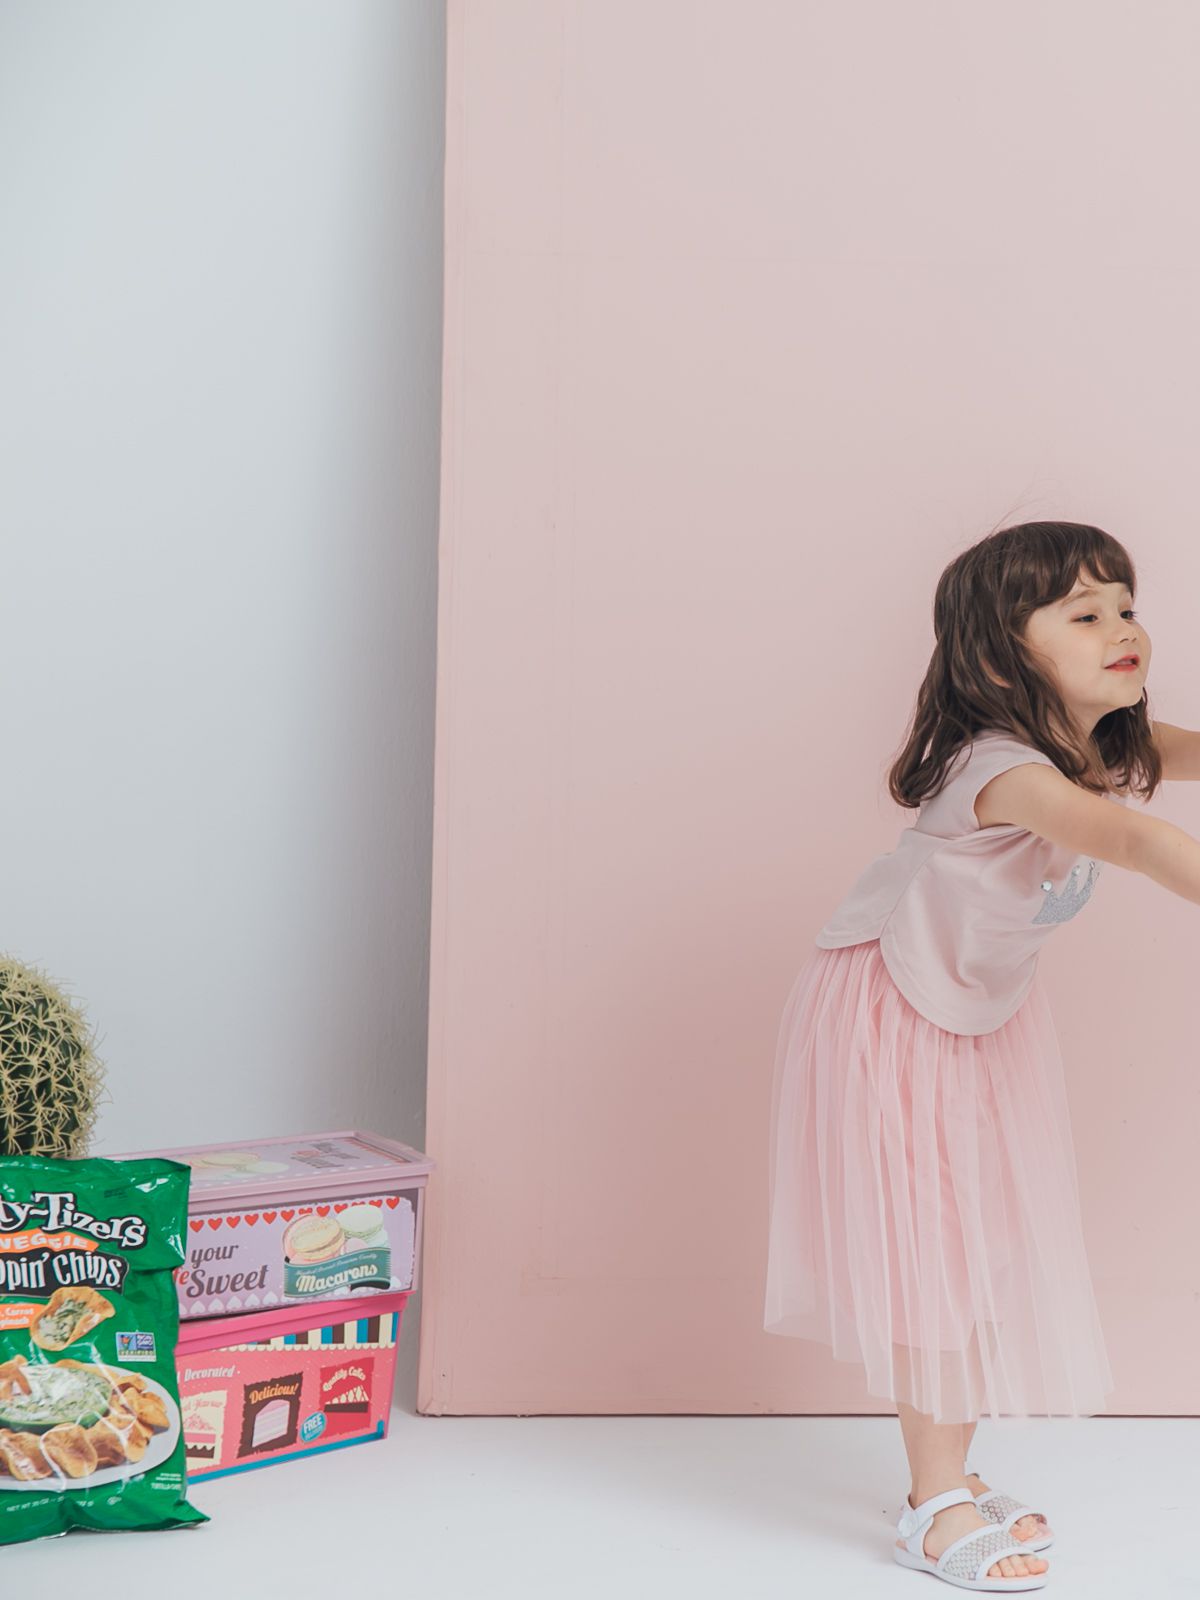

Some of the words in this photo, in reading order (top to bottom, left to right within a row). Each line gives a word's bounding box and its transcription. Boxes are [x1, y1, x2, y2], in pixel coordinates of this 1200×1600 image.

[190, 1243, 239, 1269] your
[185, 1264, 269, 1298] Sweet
[295, 1264, 378, 1293] Macarons
[184, 1365, 237, 1382] Decorated
[249, 1382, 300, 1405] Delicious!
[304, 1415, 323, 1434] FREE
